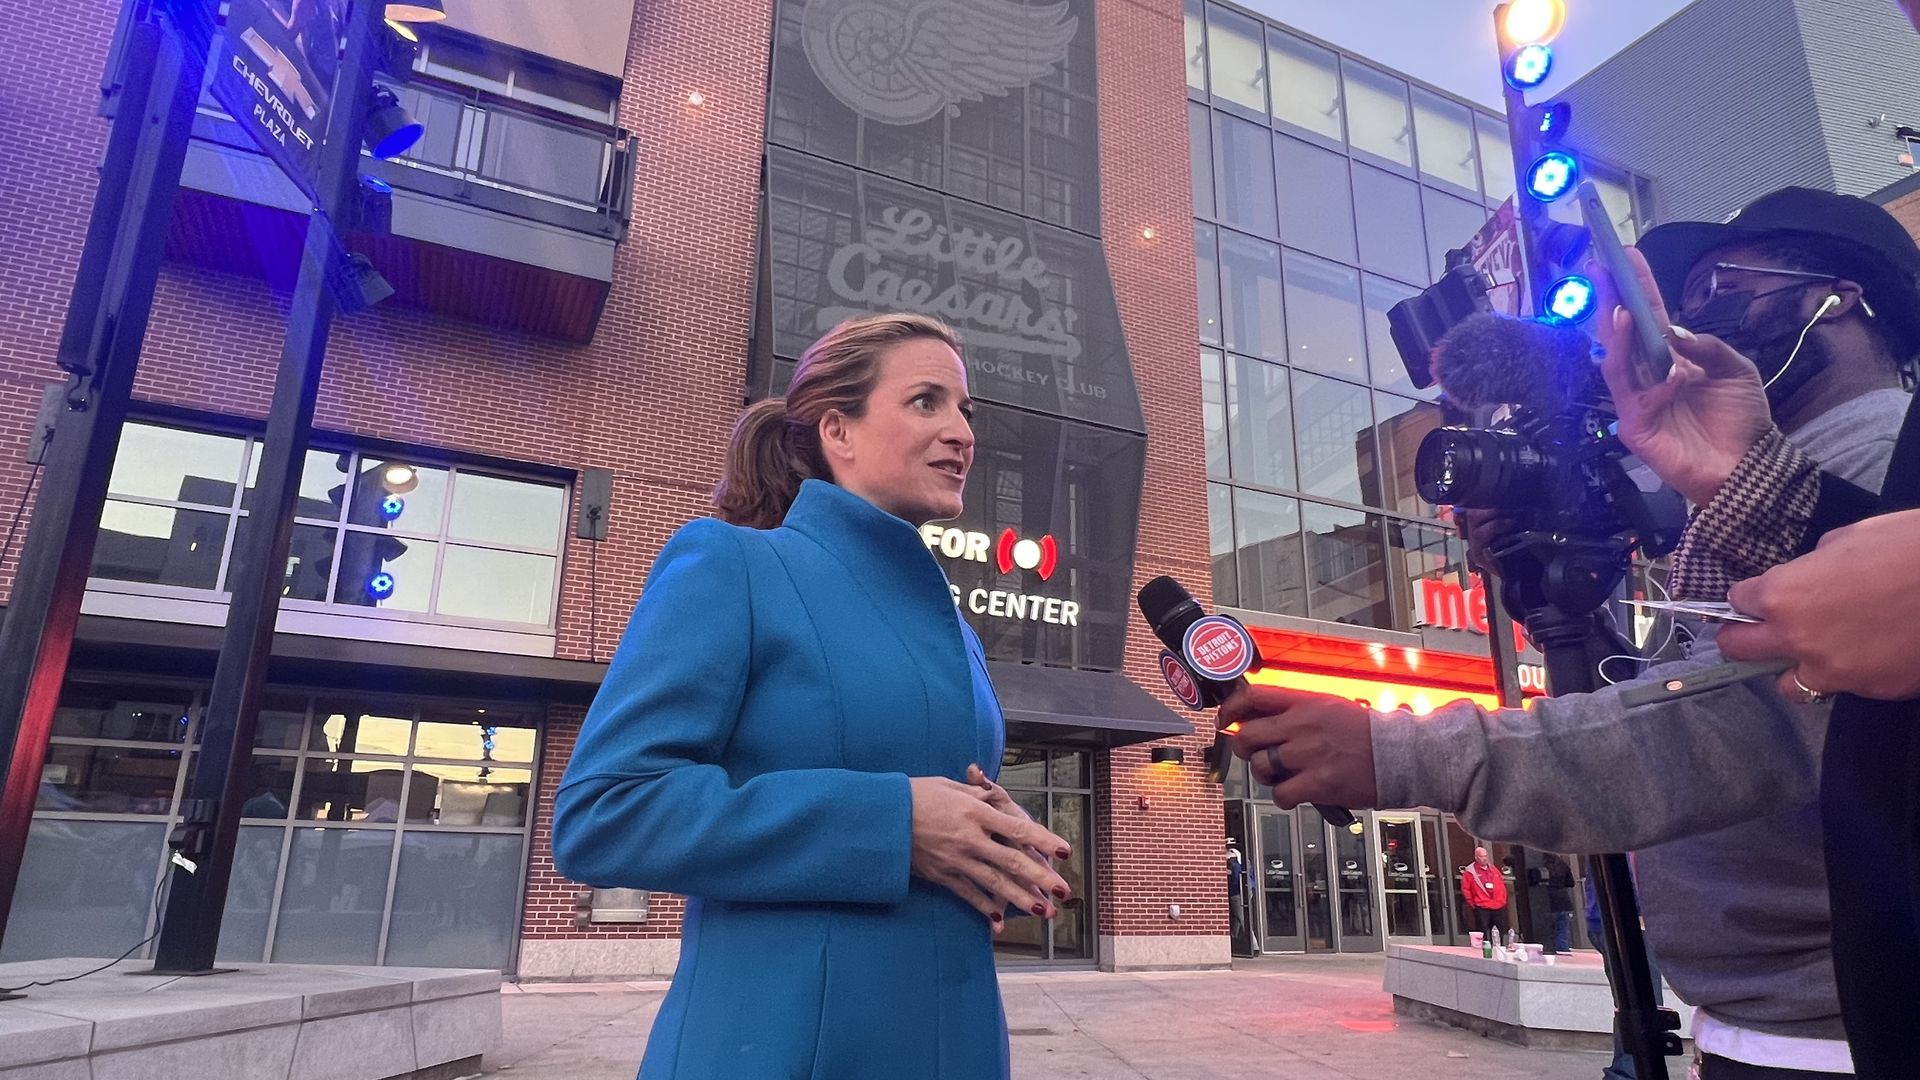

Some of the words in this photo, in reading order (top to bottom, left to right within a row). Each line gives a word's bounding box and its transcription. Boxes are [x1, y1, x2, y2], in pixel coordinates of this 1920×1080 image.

[232, 55, 315, 150] CHEVROLET
[253, 103, 286, 147] PLAZA
[865, 206, 1050, 288] Little
[827, 243, 1065, 337] Caesars
[967, 359, 1049, 386] HOCKEY
[1056, 376, 1107, 399] CLUB
[921, 524, 991, 563] FOR
[968, 588, 1080, 627] CENTER
[1413, 578, 1490, 635] me
[1196, 630, 1232, 656] DETROIT
[1202, 638, 1240, 665] PISTONS
[1517, 664, 1547, 690] OU
